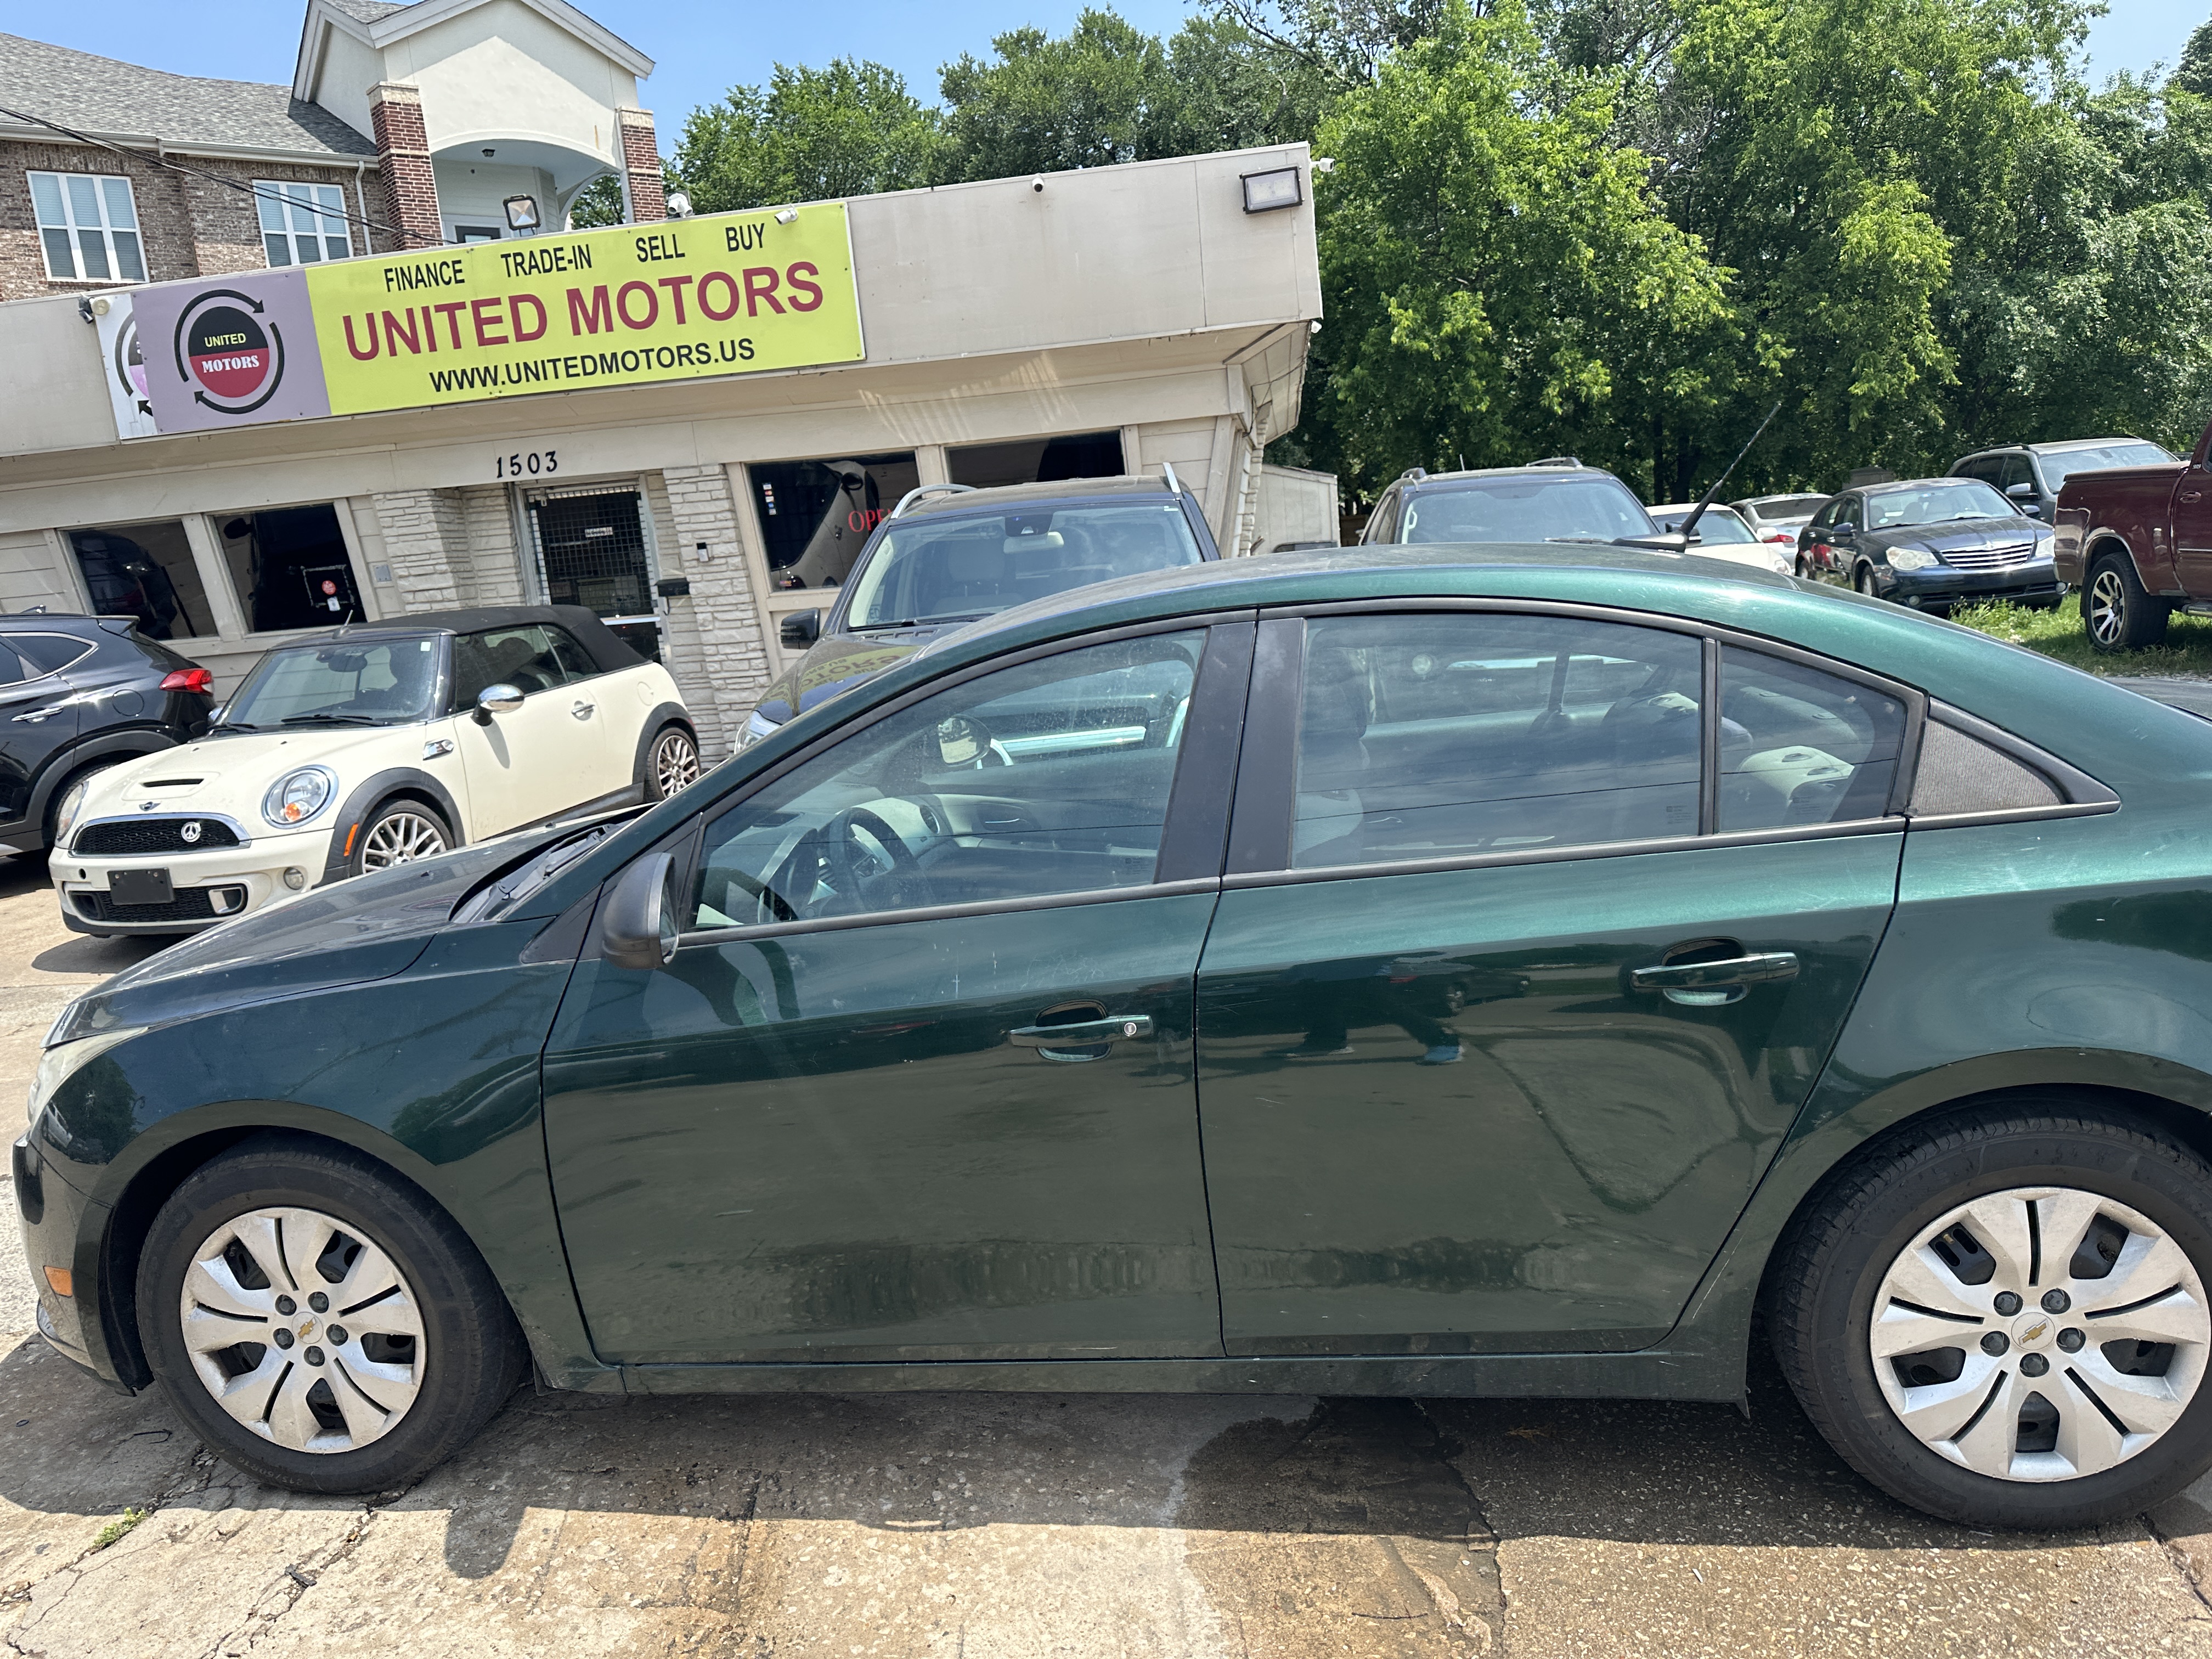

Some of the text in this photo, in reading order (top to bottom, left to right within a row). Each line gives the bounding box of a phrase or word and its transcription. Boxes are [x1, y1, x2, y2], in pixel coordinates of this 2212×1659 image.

[383, 223, 765, 292] FINANCE TRADE-IN SELL BUY
[342, 261, 823, 361] UNITED MOTORS
[205, 332, 246, 348] UNITED
[201, 355, 259, 374] MOTORS
[429, 338, 755, 392] WWW.UNITEDMOTORS.US
[496, 450, 558, 479] 1503
[848, 508, 892, 533] OPE
